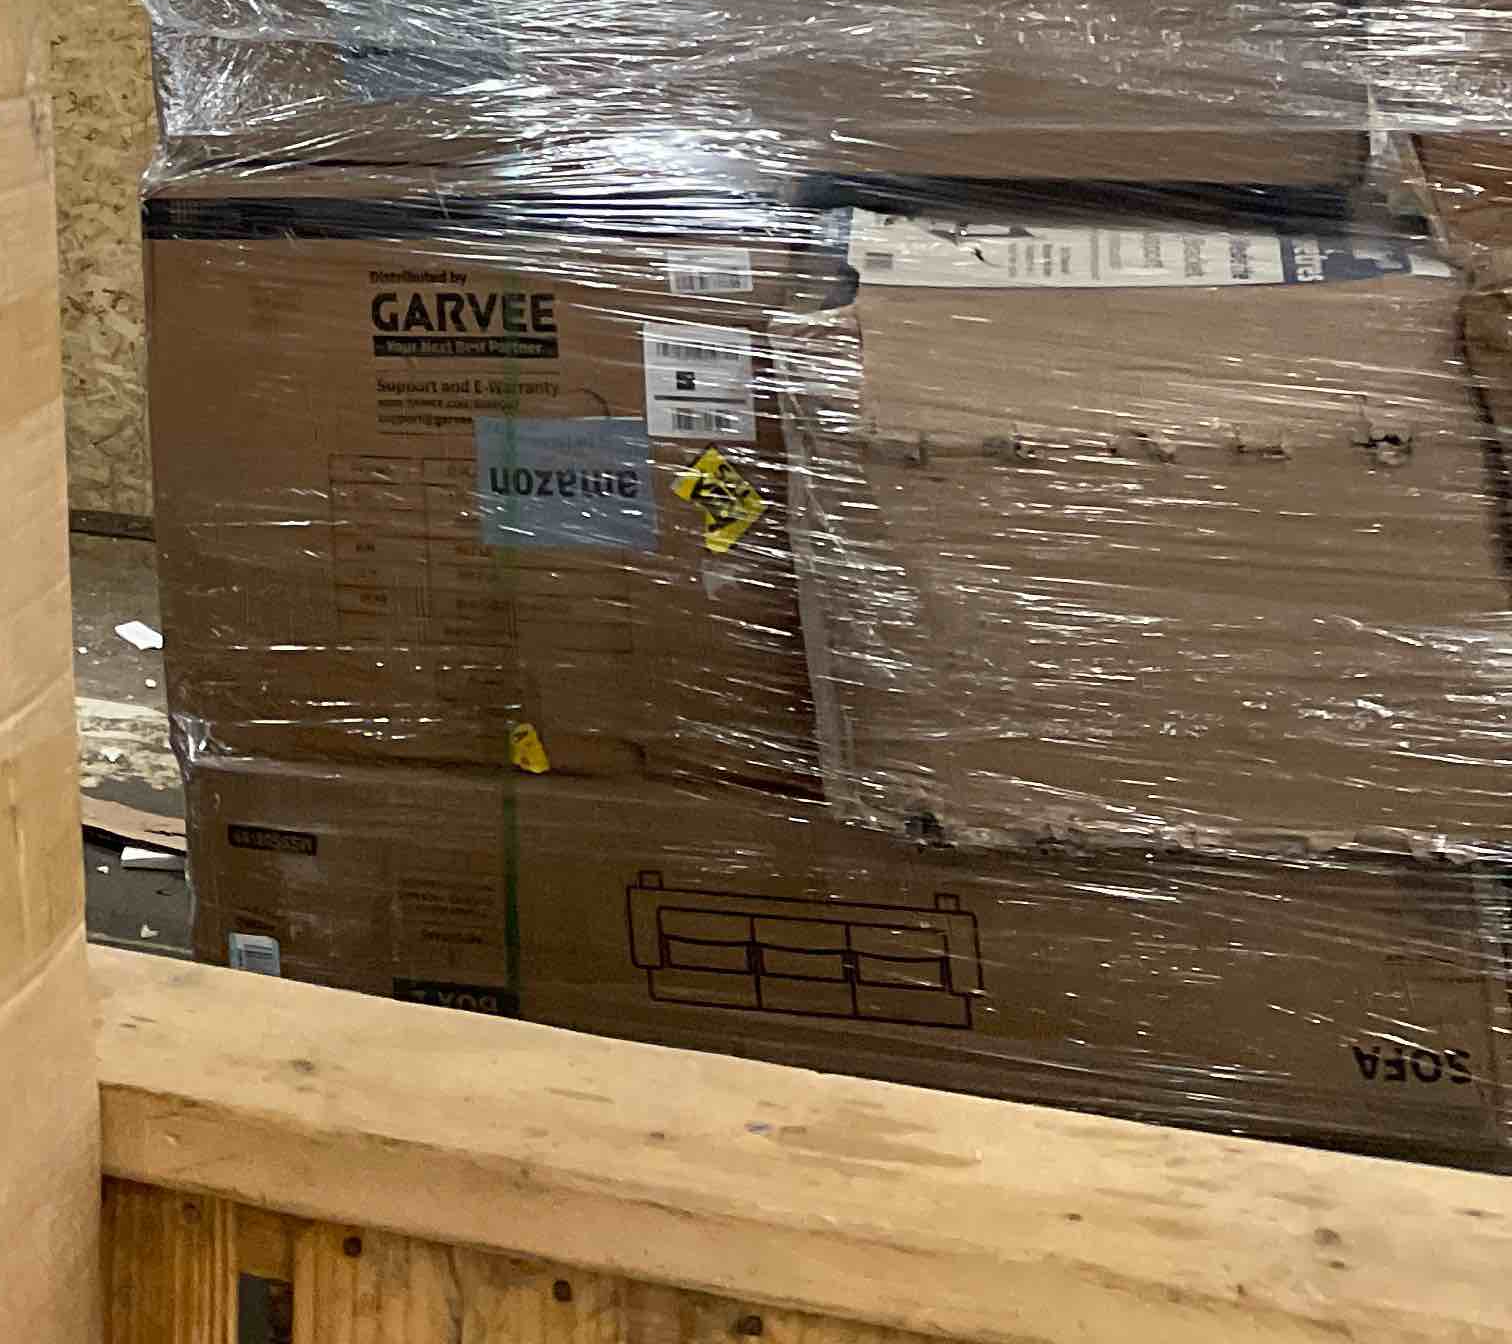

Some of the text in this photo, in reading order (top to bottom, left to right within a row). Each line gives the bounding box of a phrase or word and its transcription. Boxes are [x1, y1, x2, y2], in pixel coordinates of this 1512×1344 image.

[450, 270, 468, 288] by
[371, 292, 559, 334] GARVEE
[376, 377, 438, 395] Support
[441, 379, 470, 394] and
[488, 465, 640, 499] amazon
[1351, 1045, 1473, 1084] SOFA
